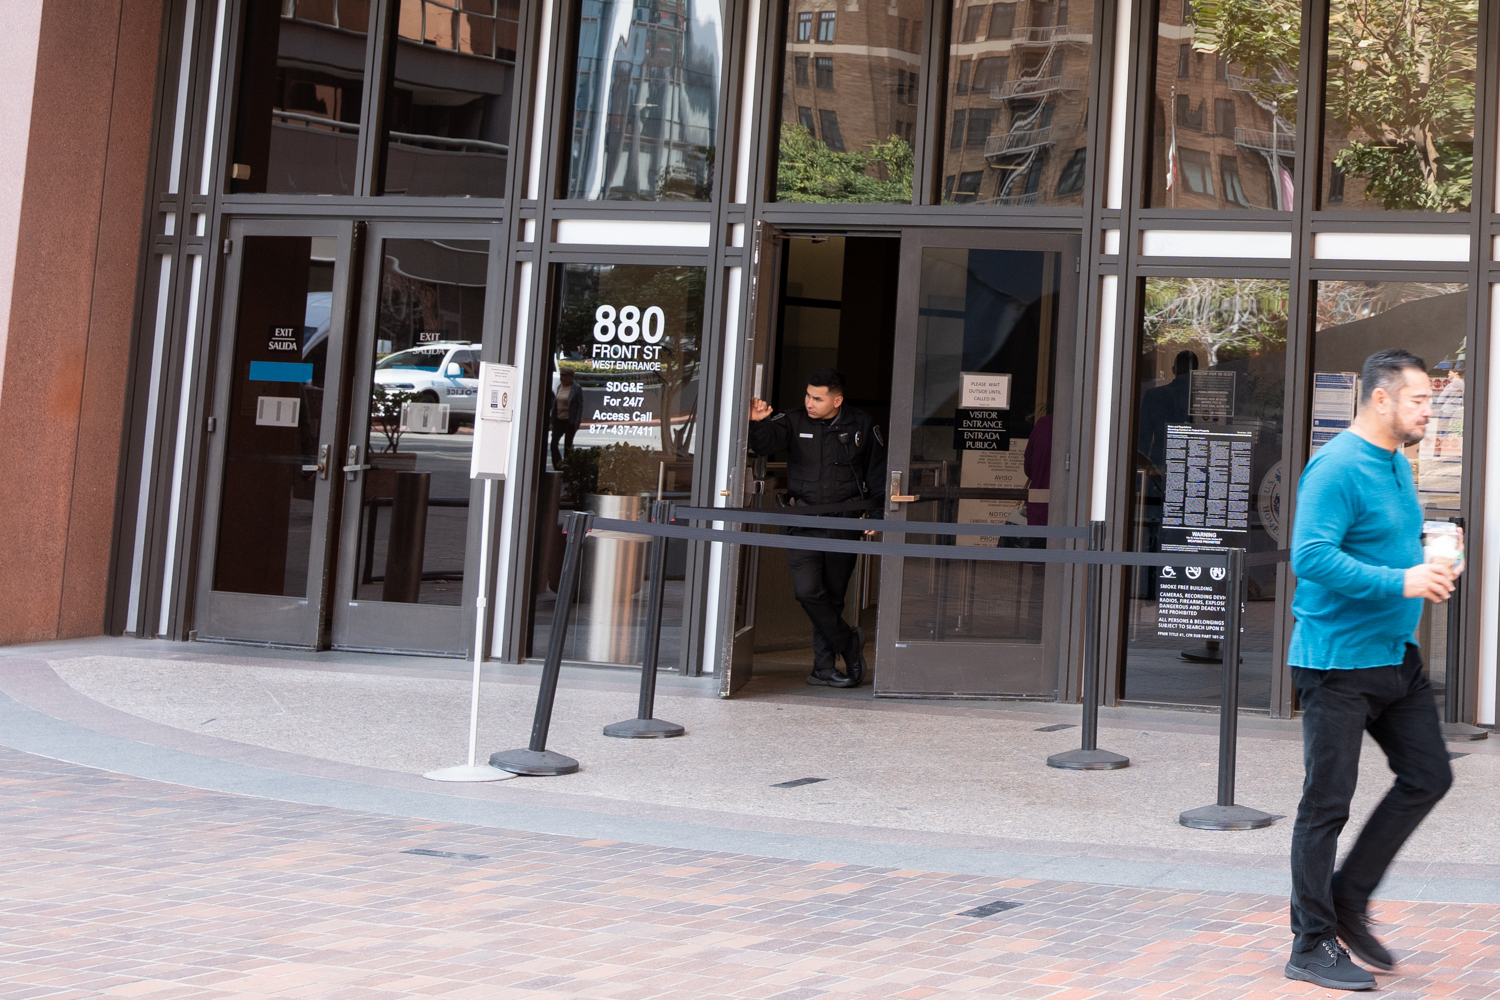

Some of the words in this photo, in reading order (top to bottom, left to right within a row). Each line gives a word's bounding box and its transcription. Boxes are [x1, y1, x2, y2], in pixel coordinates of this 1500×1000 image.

[593, 304, 665, 344] 880
[275, 327, 294, 337] EXIT
[420, 332, 441, 342] EXIT
[268, 340, 298, 351] SALIDA
[592, 344, 641, 358] FRONT
[643, 346, 662, 360] ST
[592, 360, 616, 370] WEST
[616, 361, 661, 371] ENTRANCE
[606, 382, 644, 392] SDG&E
[604, 396, 621, 406] For
[623, 397, 644, 407] 24/7
[592, 410, 630, 421] Access
[632, 412, 652, 422] Call
[963, 420, 1003, 428] ENTRANCE
[589, 424, 653, 436] 877-437-7411
[964, 432, 1000, 440] ENTRADA
[966, 441, 997, 449] PUBLICA
